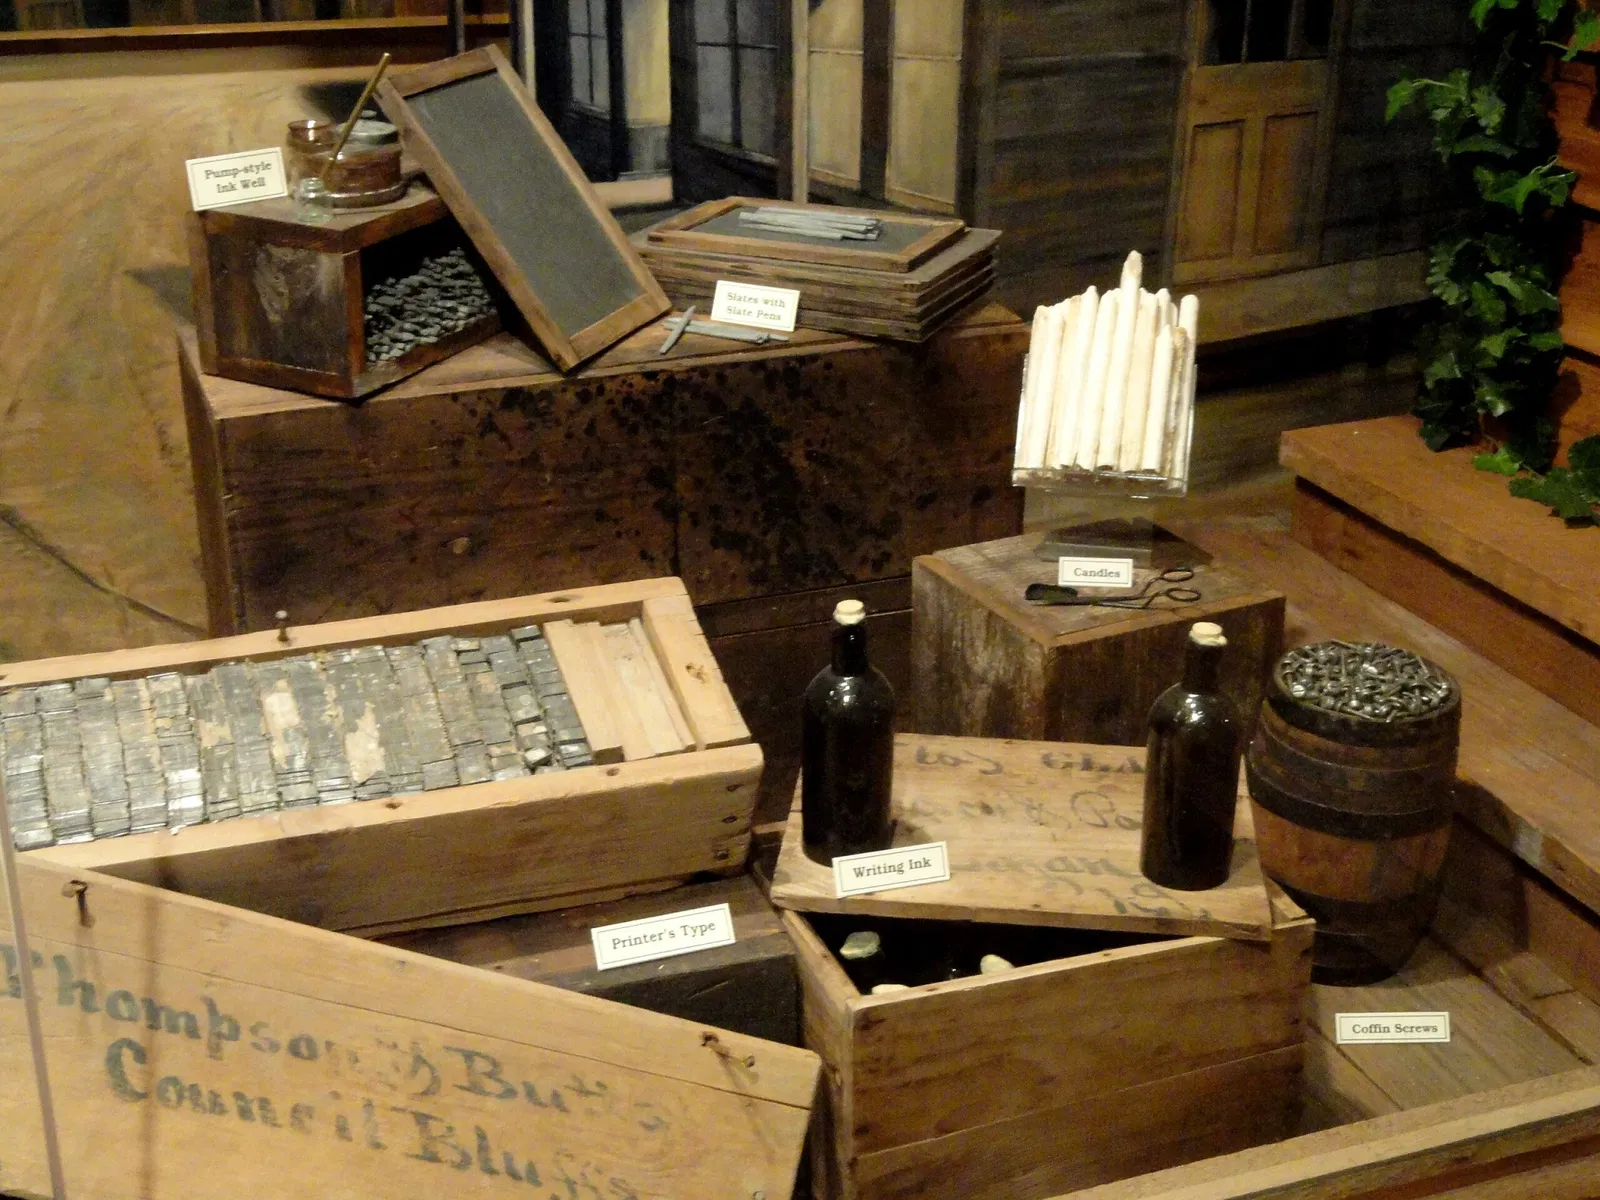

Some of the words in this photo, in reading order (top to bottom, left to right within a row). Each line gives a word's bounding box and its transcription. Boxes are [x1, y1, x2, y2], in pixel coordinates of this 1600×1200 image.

[204, 161, 272, 179] Pump-style
[216, 182, 238, 193] Ink
[240, 177, 266, 189] Well
[727, 292, 759, 304] Slates
[763, 298, 786, 308] with
[727, 305, 753, 317] Slate
[756, 309, 782, 320] Pens
[1073, 567, 1121, 578] Candles
[852, 861, 905, 878] Writing
[908, 857, 932, 870] Ink
[611, 928, 676, 950] Printer's
[680, 922, 717, 937] Type
[1351, 1024, 1391, 1034] Coffin
[1394, 1023, 1439, 1033] Screws
[105, 1037, 388, 1150] Council
